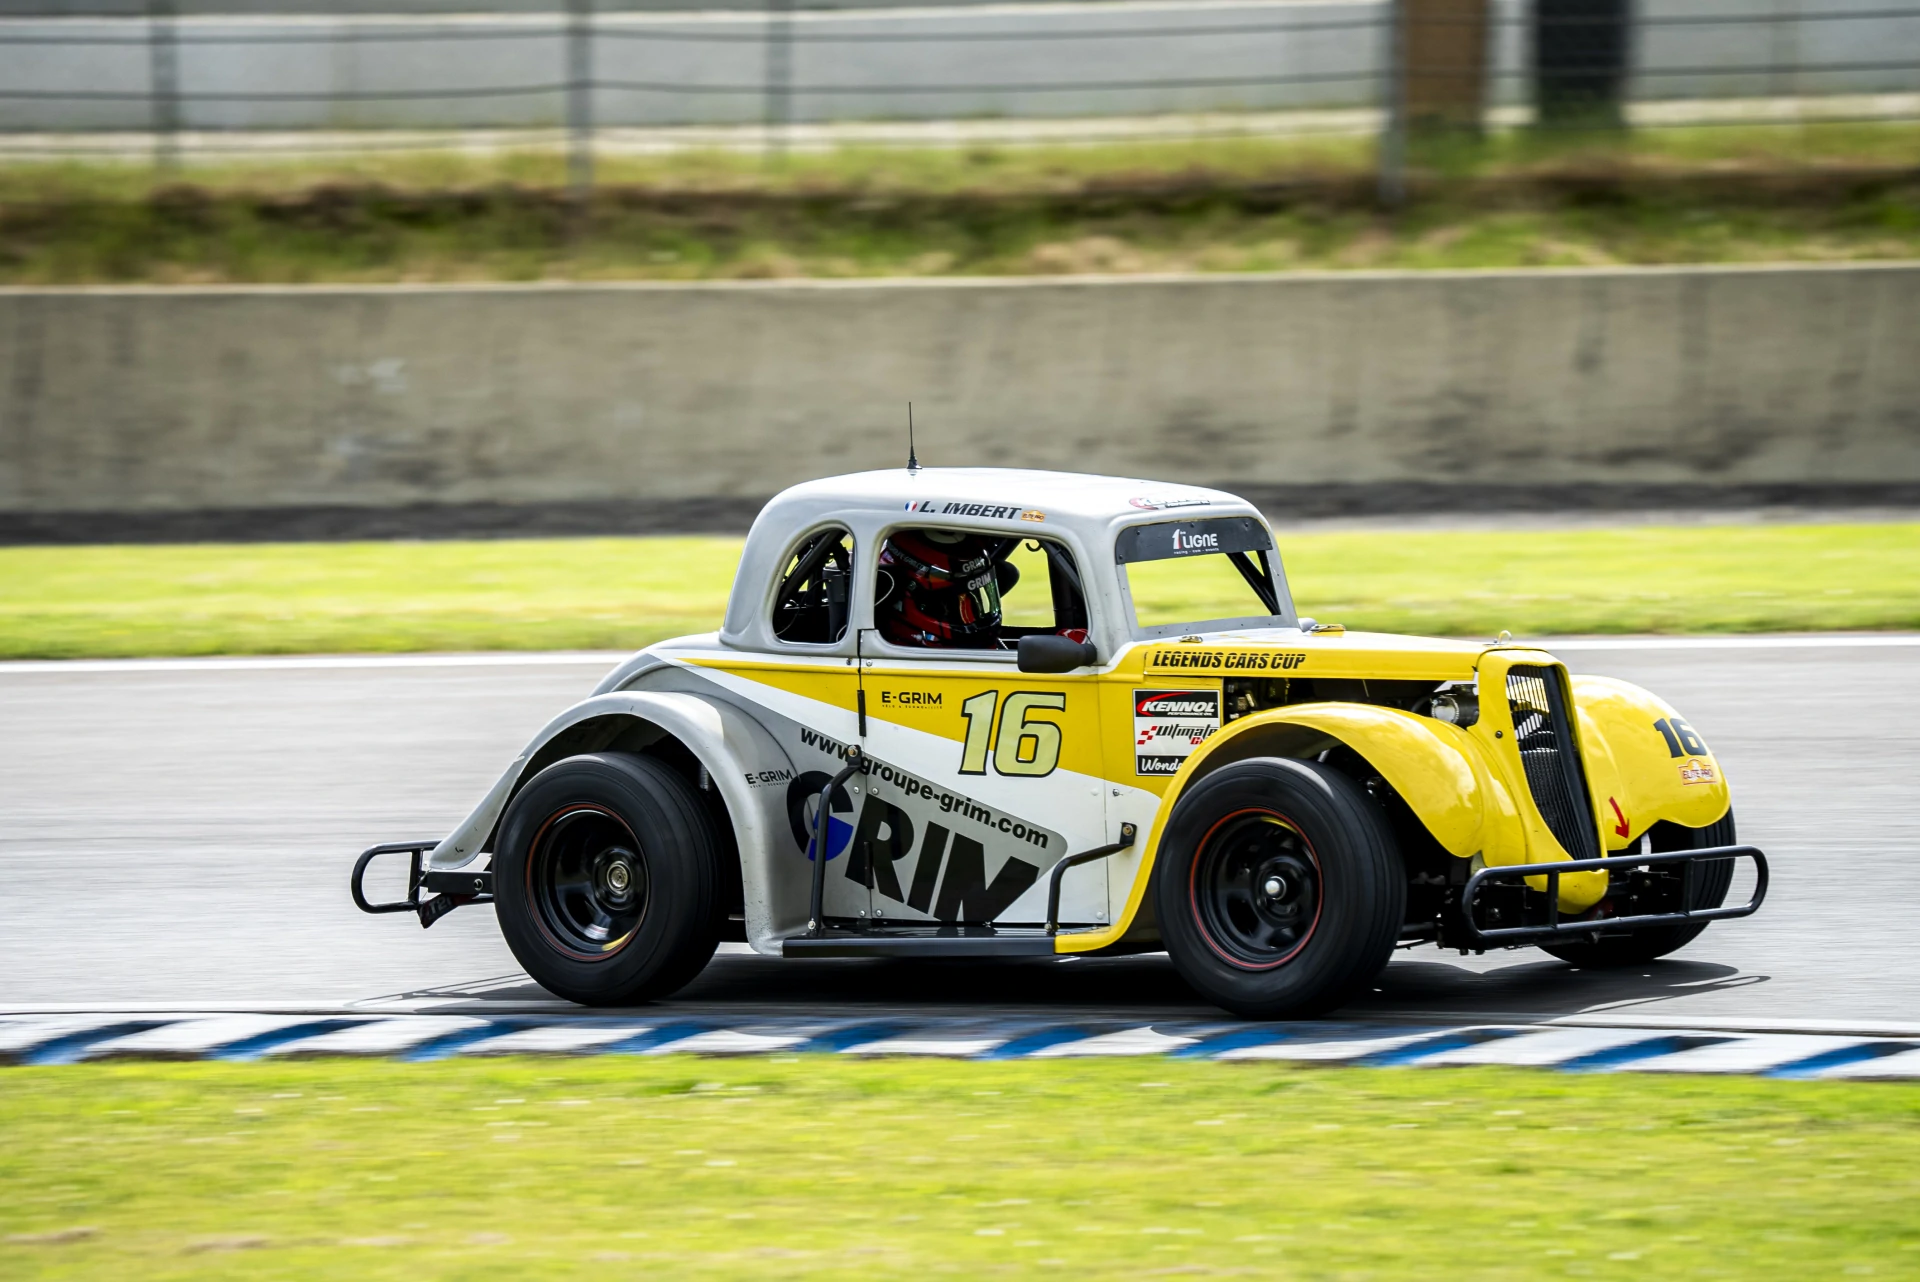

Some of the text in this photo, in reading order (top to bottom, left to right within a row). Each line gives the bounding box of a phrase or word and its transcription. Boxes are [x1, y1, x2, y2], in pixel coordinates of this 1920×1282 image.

[919, 501, 1022, 519] L. IMBERT
[1182, 534, 1218, 548] LIGNE
[967, 573, 991, 591] GRIM
[1153, 651, 1306, 669] LEGENDS CARS CUP
[881, 691, 942, 704] E-GRIM
[1141, 701, 1215, 712] KENNOL
[958, 689, 1066, 778] 16
[1653, 718, 1707, 758] 16
[744, 769, 793, 784] E-GRIM
[786, 770, 1040, 922] GRIM
